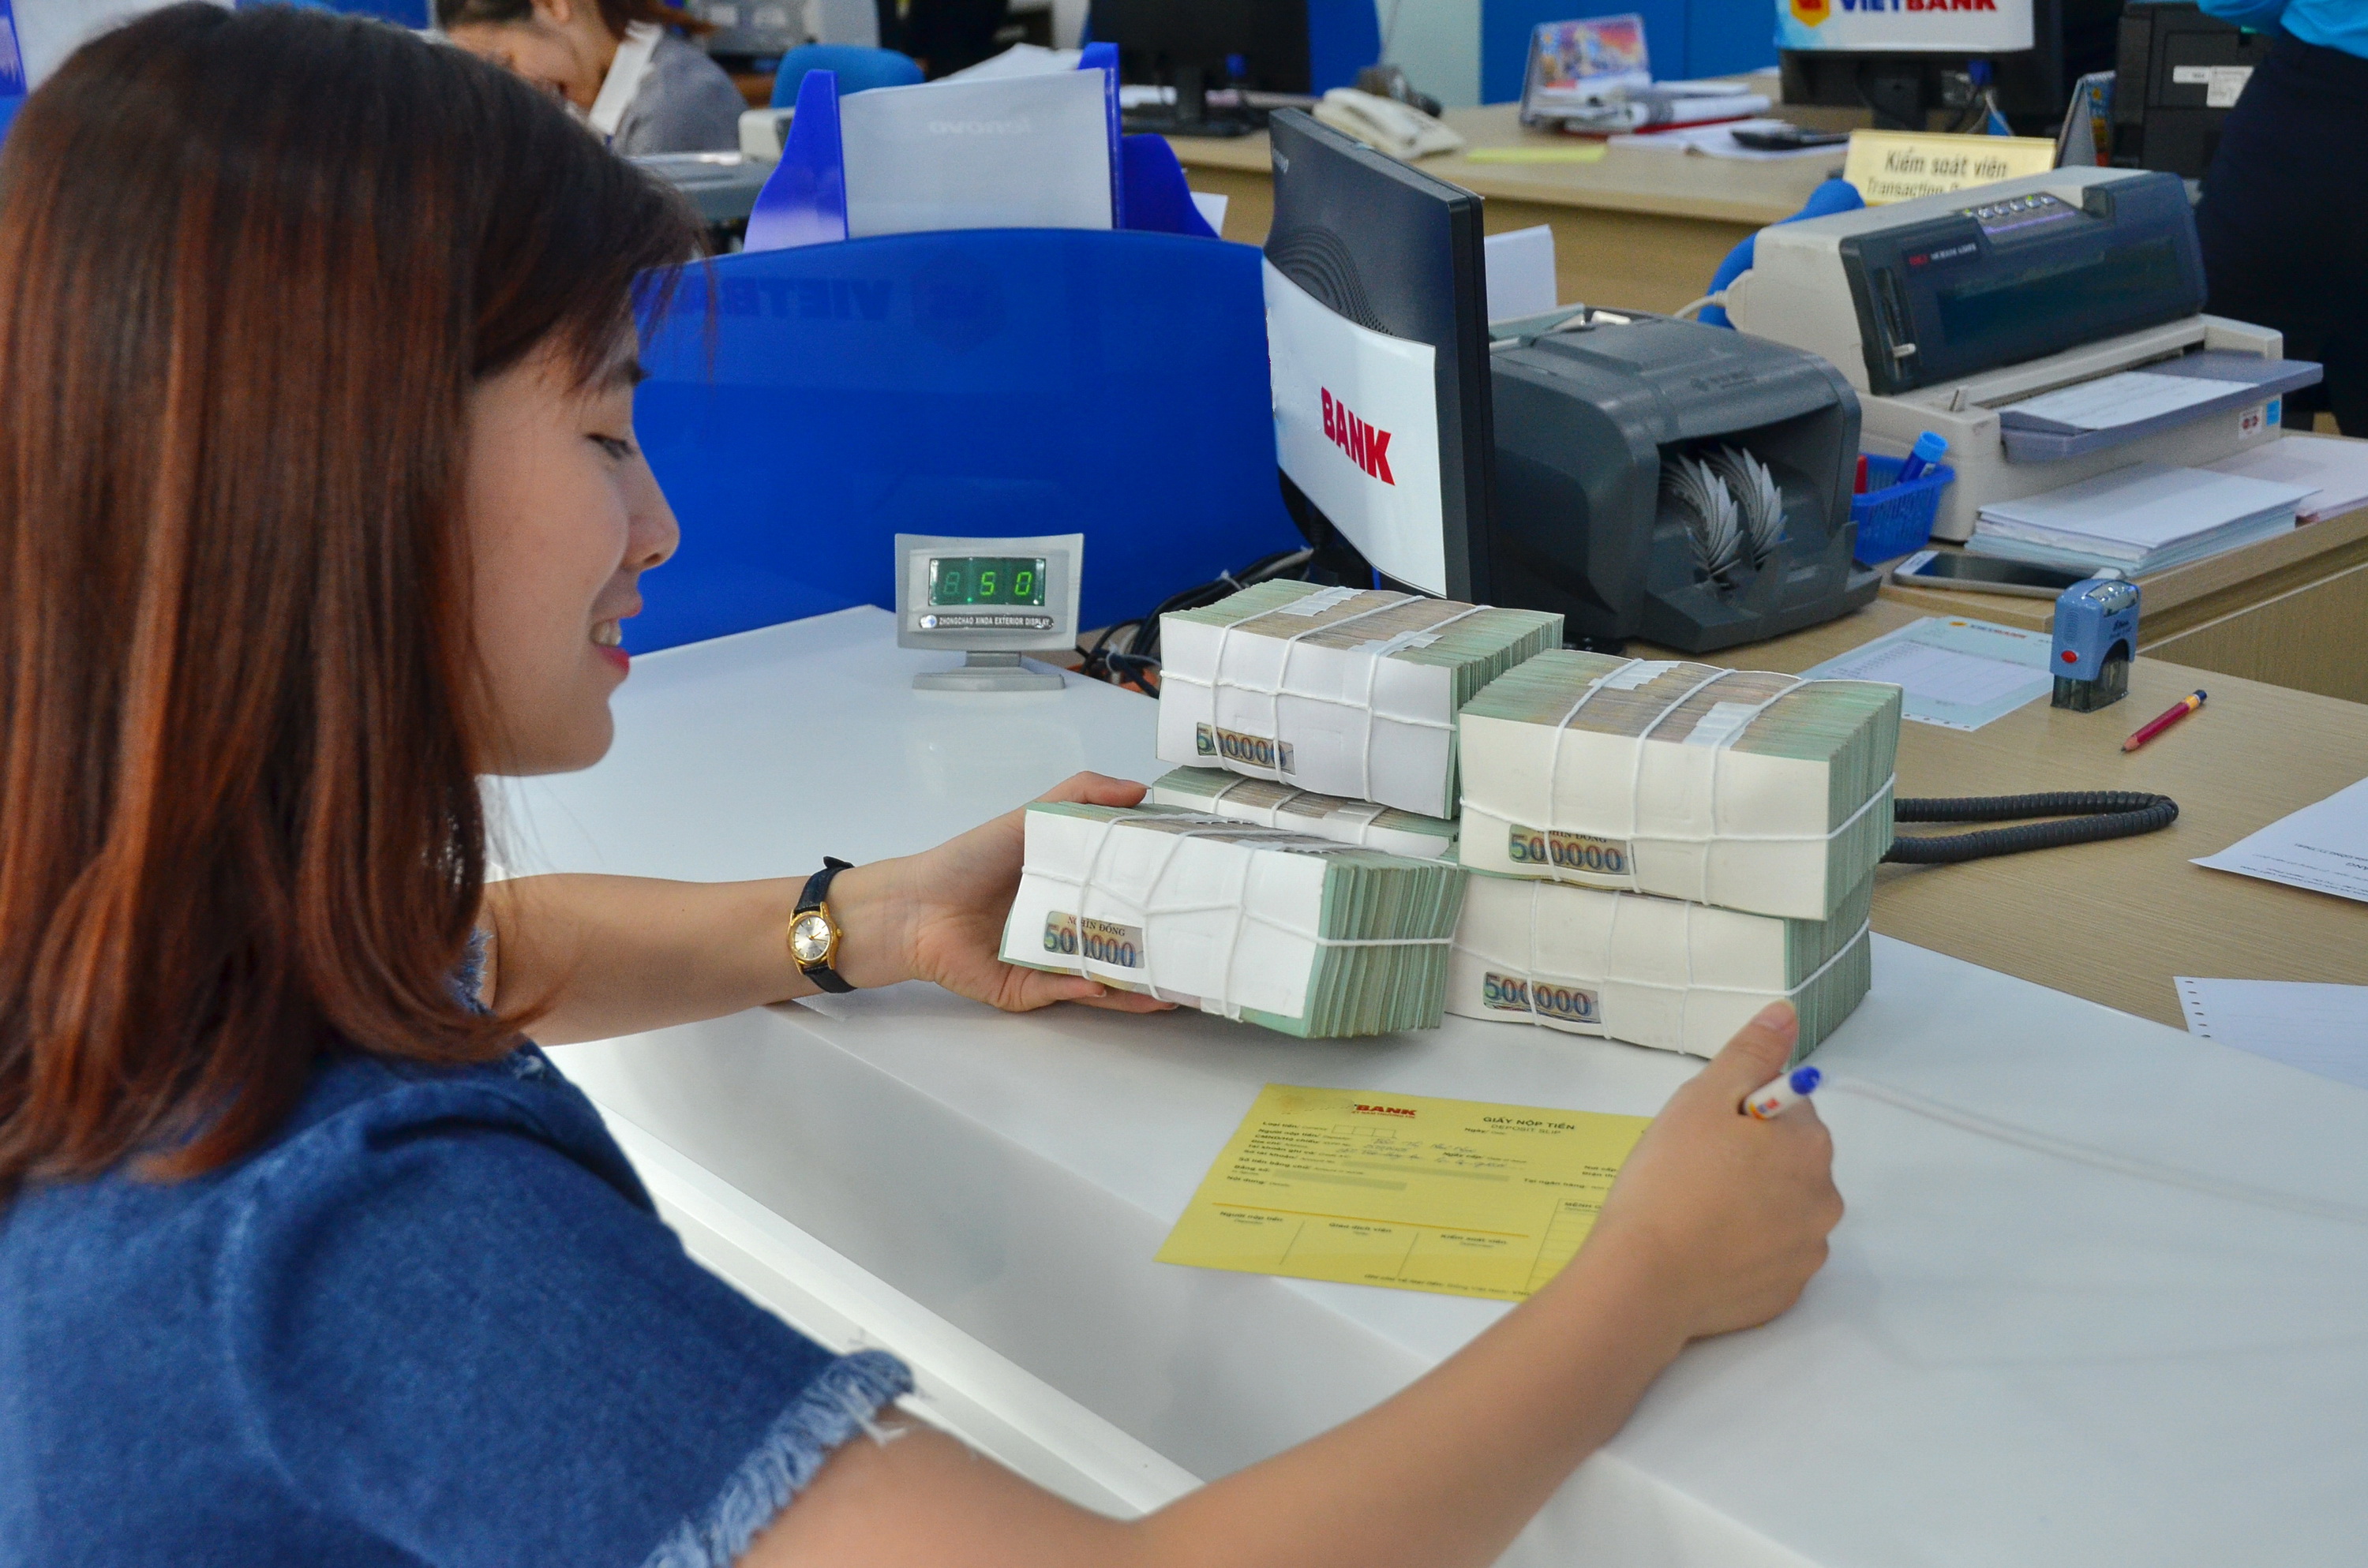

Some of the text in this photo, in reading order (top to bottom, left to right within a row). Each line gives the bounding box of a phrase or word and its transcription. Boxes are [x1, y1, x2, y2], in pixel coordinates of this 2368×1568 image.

[1885, 146, 2007, 178] Kiểm soát viên
[1321, 385, 1396, 486] BANK
[1356, 1104, 1417, 1116] BANK
[1491, 1124, 1536, 1132] DEPOSIT
[1516, 1117, 1543, 1128] NỘP
